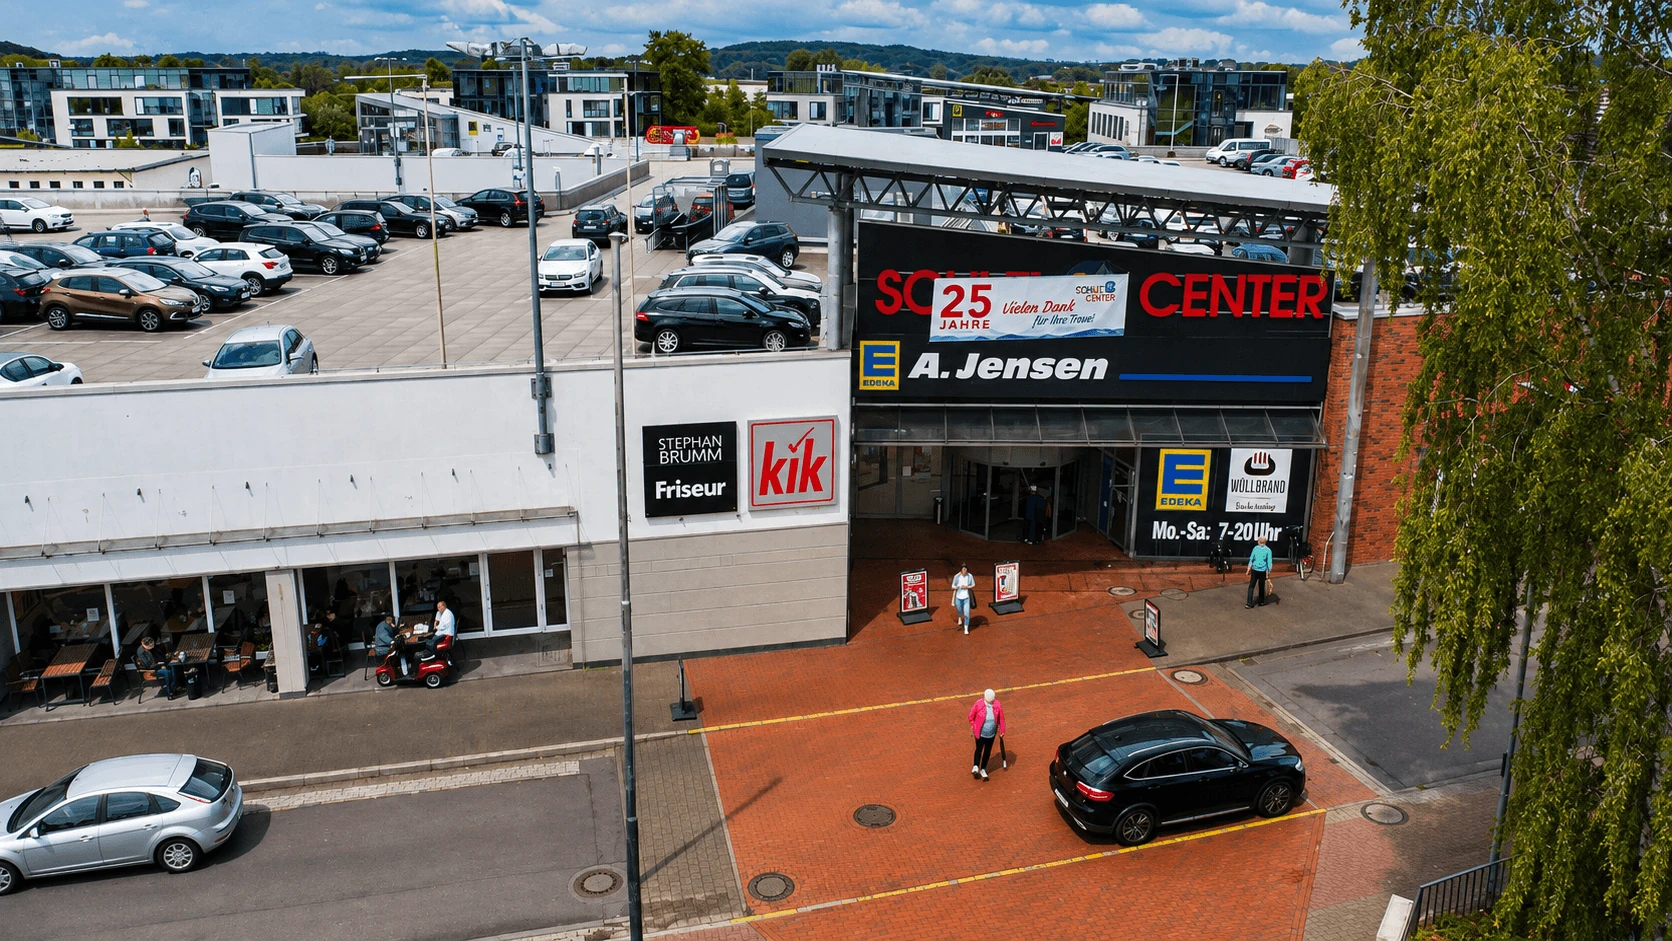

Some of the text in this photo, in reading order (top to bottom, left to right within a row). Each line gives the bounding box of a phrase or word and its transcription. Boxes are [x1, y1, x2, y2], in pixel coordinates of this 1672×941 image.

[940, 284, 992, 319] 25
[1085, 294, 1116, 302] CENTER
[1139, 272, 1328, 318] CENTER
[1003, 299, 1076, 314] Vielen Dank
[939, 319, 991, 330] JAHRE
[1050, 314, 1068, 325] Ihre
[907, 353, 1109, 380] A. Jensen
[658, 435, 723, 450] STEPHAN
[660, 448, 723, 465] BRUMM
[759, 427, 828, 496] kik
[655, 479, 727, 500] Friseur
[1160, 497, 1202, 507] EDEKA
[1152, 520, 1212, 541] Mo.-Sa:
